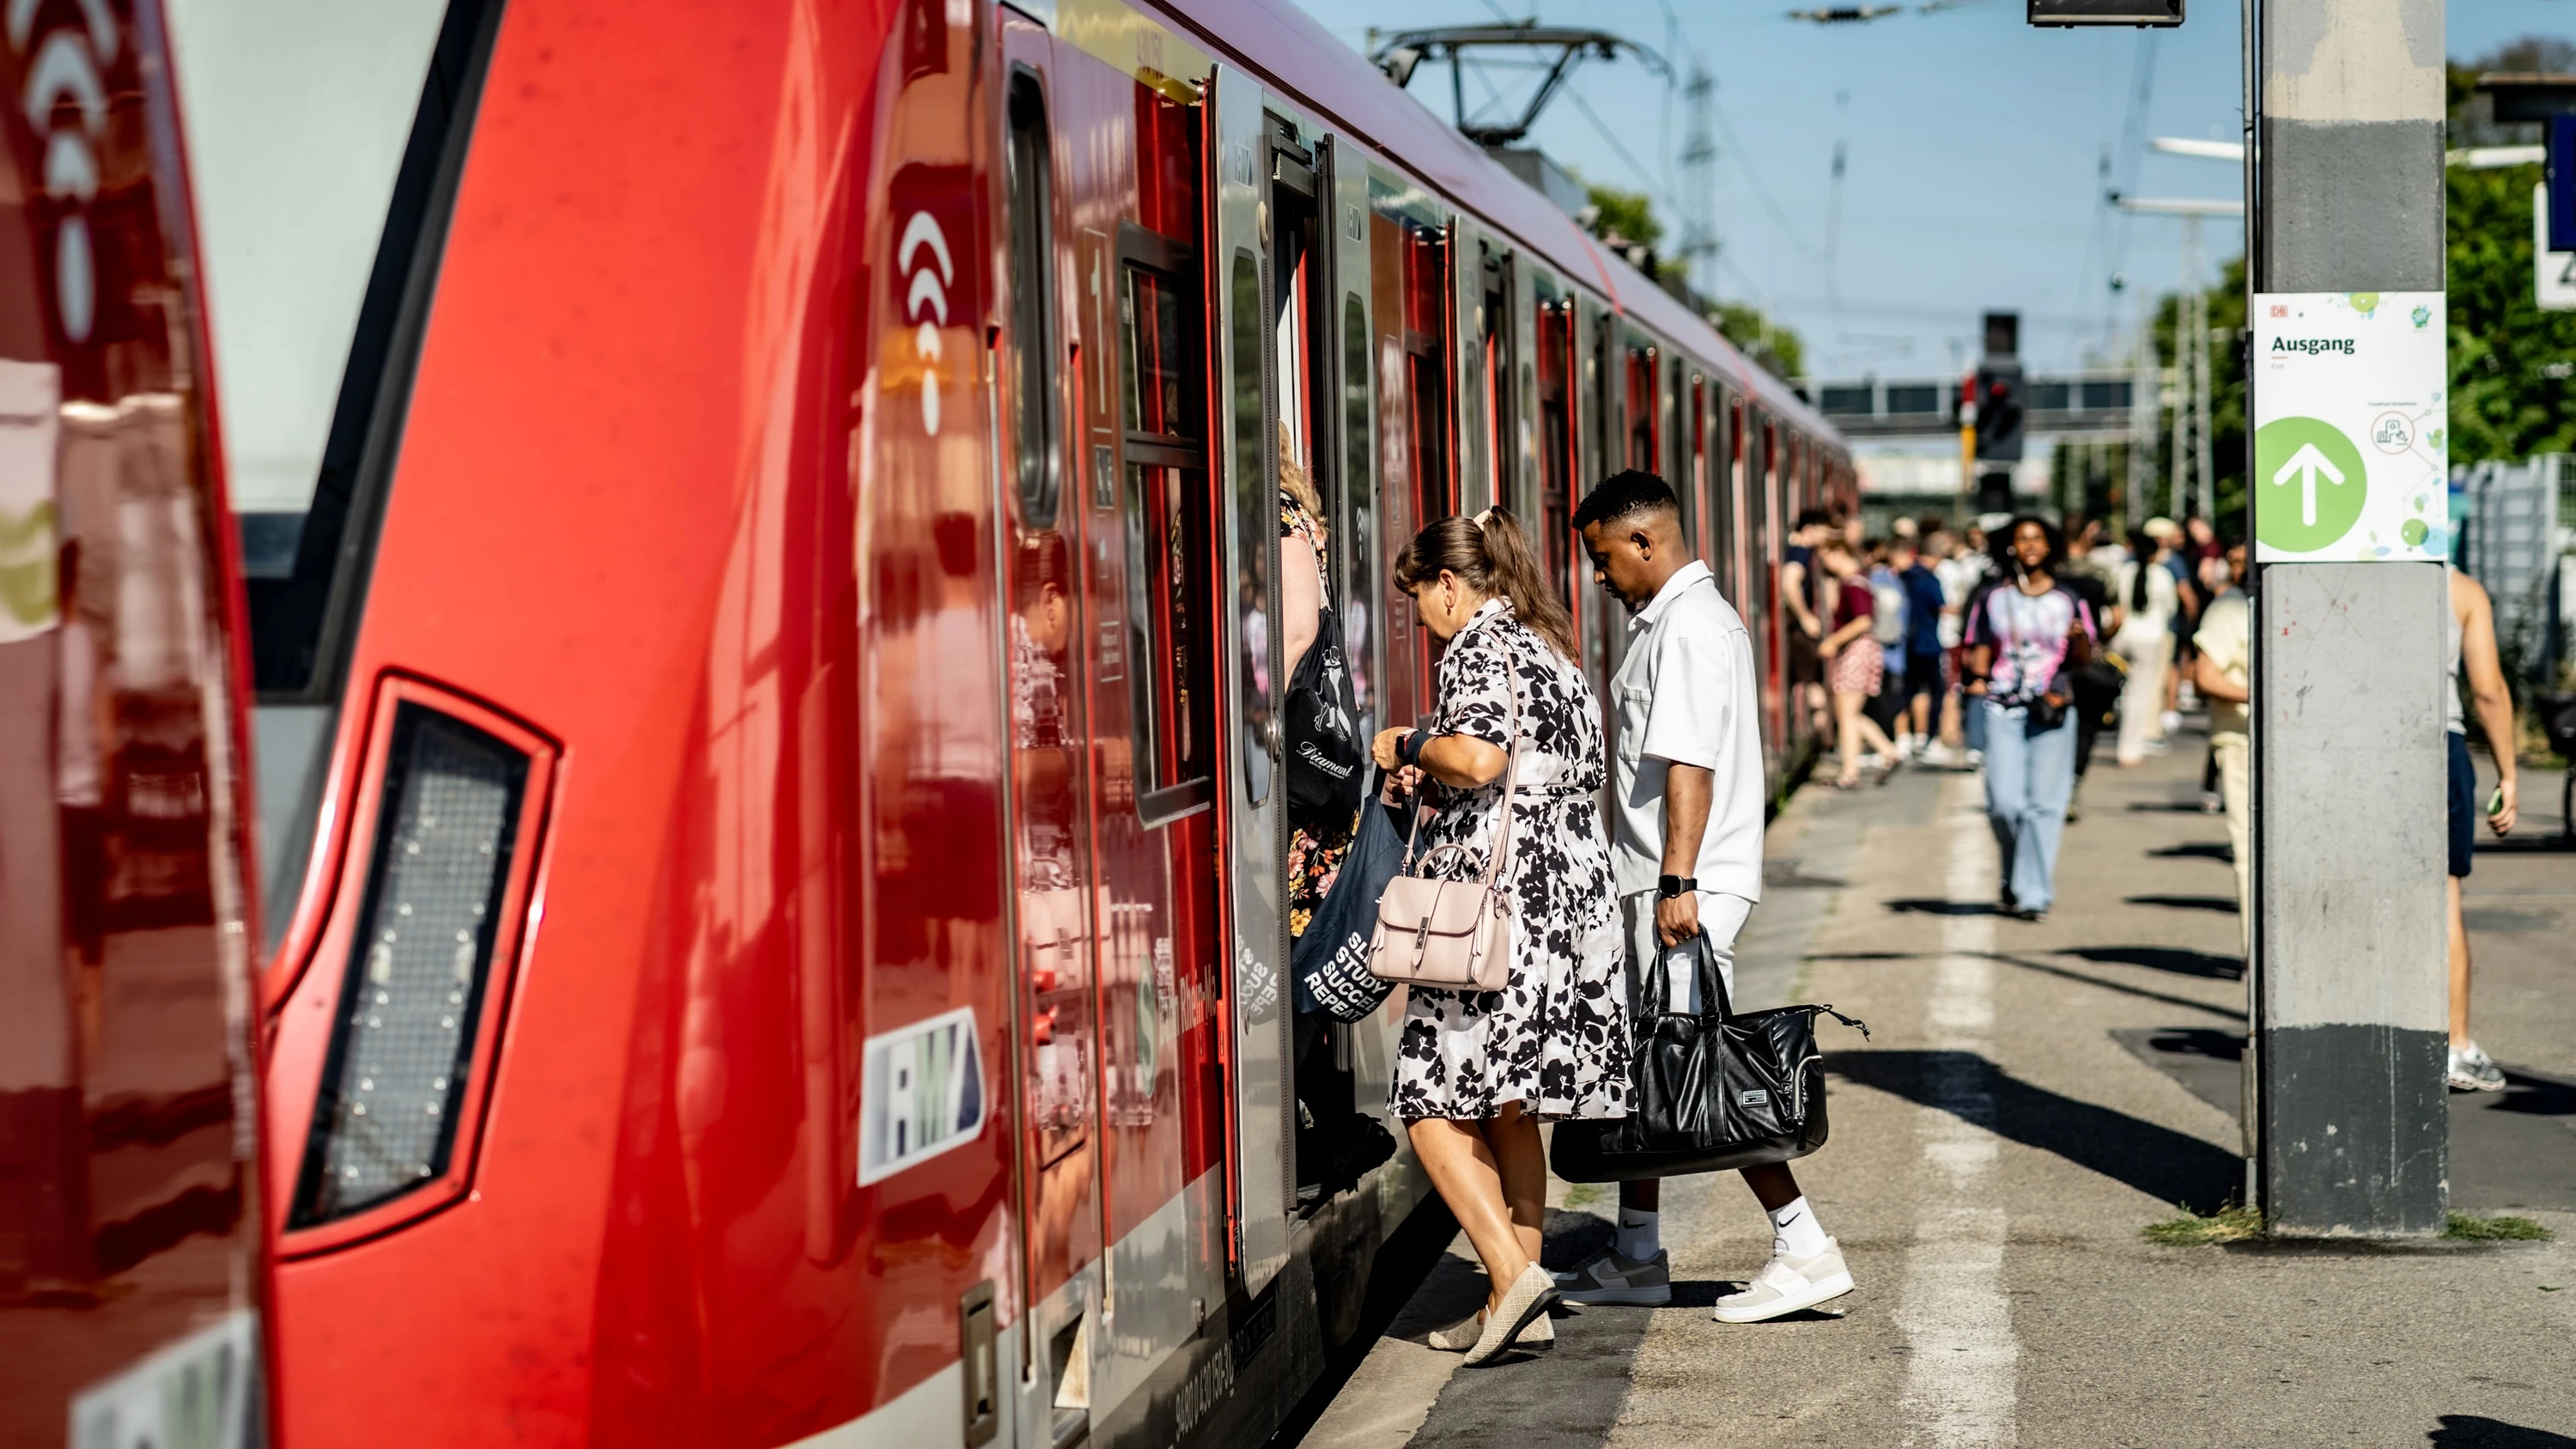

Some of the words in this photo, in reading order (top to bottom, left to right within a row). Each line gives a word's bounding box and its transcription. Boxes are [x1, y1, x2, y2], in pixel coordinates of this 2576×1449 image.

[2271, 336, 2354, 355] Ausgang
[1296, 741, 1353, 777] Diamant
[1336, 946, 1387, 994] STUDY
